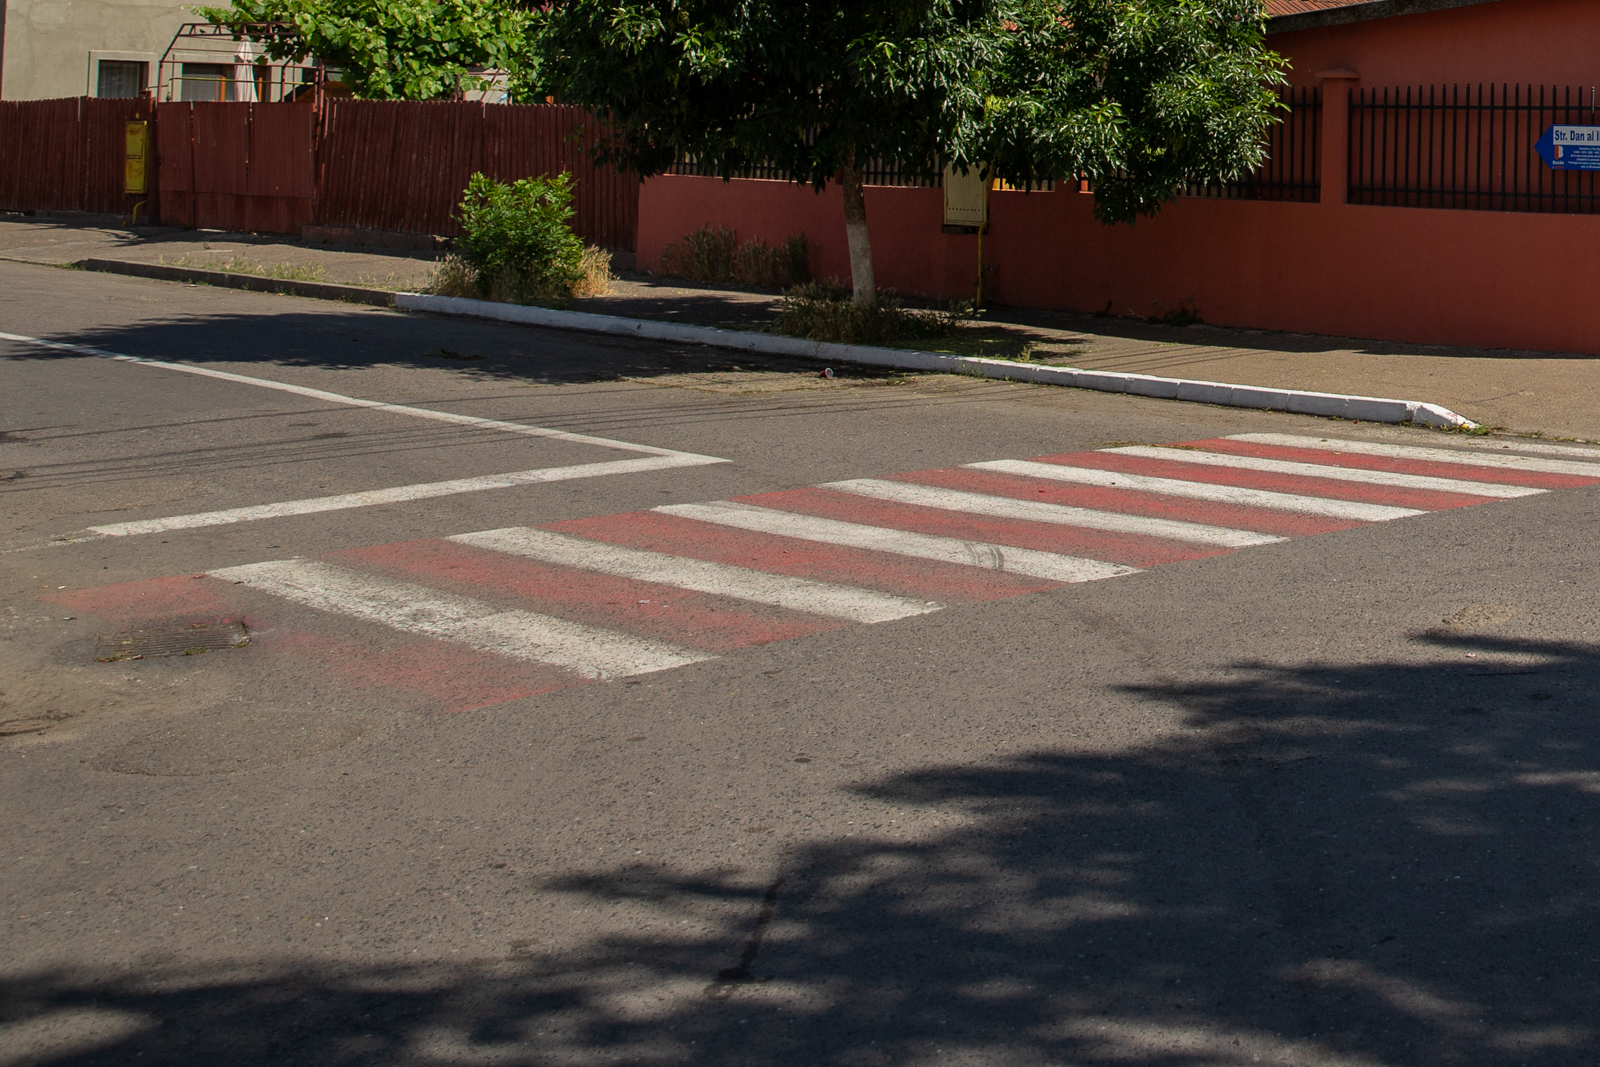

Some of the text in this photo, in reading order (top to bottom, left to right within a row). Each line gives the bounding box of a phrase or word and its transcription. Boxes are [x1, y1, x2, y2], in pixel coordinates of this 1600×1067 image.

[1554, 129, 1568, 141] Str.
[1570, 130, 1585, 142] Dan
[1586, 130, 1595, 142] al
